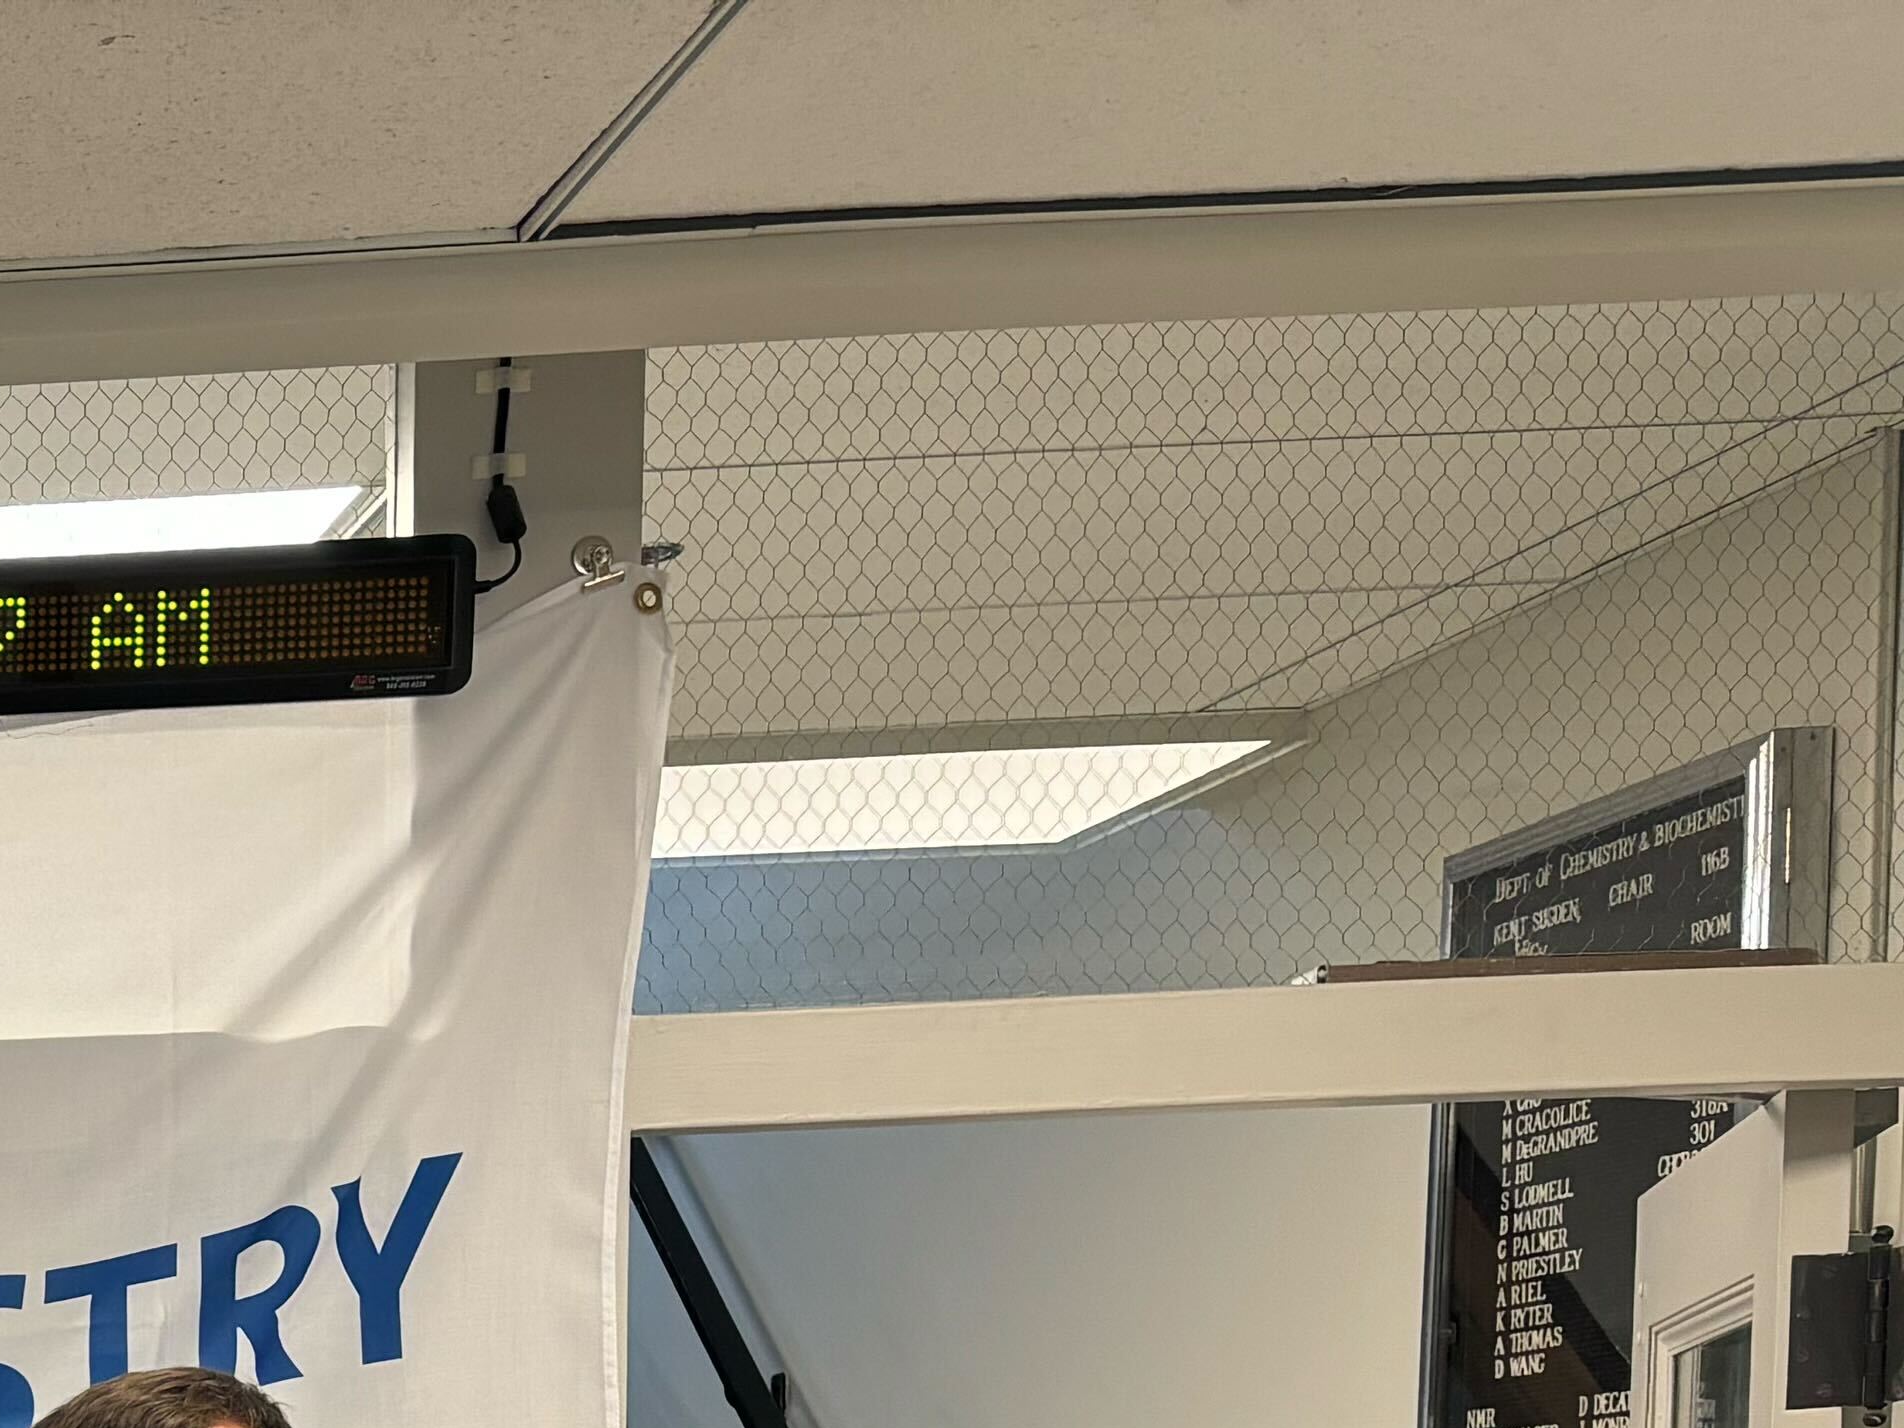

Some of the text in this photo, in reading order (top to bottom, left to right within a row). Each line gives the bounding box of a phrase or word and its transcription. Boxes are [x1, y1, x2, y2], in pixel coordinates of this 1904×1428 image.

[91, 586, 213, 668] AM
[1560, 832, 1638, 880] CHEMISTRY
[1654, 794, 1745, 847] BIOCHEMIST
[1493, 846, 1730, 946] KENT CHAIR 116B
[1690, 911, 1733, 945] ROOM
[1502, 1099, 1716, 1145] M CRACOLICE 301
[1501, 1143, 1512, 1165] M
[1501, 1162, 1534, 1188] L HU
[1500, 1178, 1574, 1212] S LODMELL
[1499, 1203, 1564, 1236] B MARTIN
[1512, 1227, 1569, 1257] PALMER
[1496, 1248, 1583, 1285] N PRIESTLEY
[1496, 1280, 1547, 1308] A RIEL
[1495, 1303, 1554, 1332] K RYTER
[1494, 1326, 1564, 1356] A THOMAS
[1494, 1353, 1546, 1379] D WANG
[1578, 1396, 1588, 1417] D
